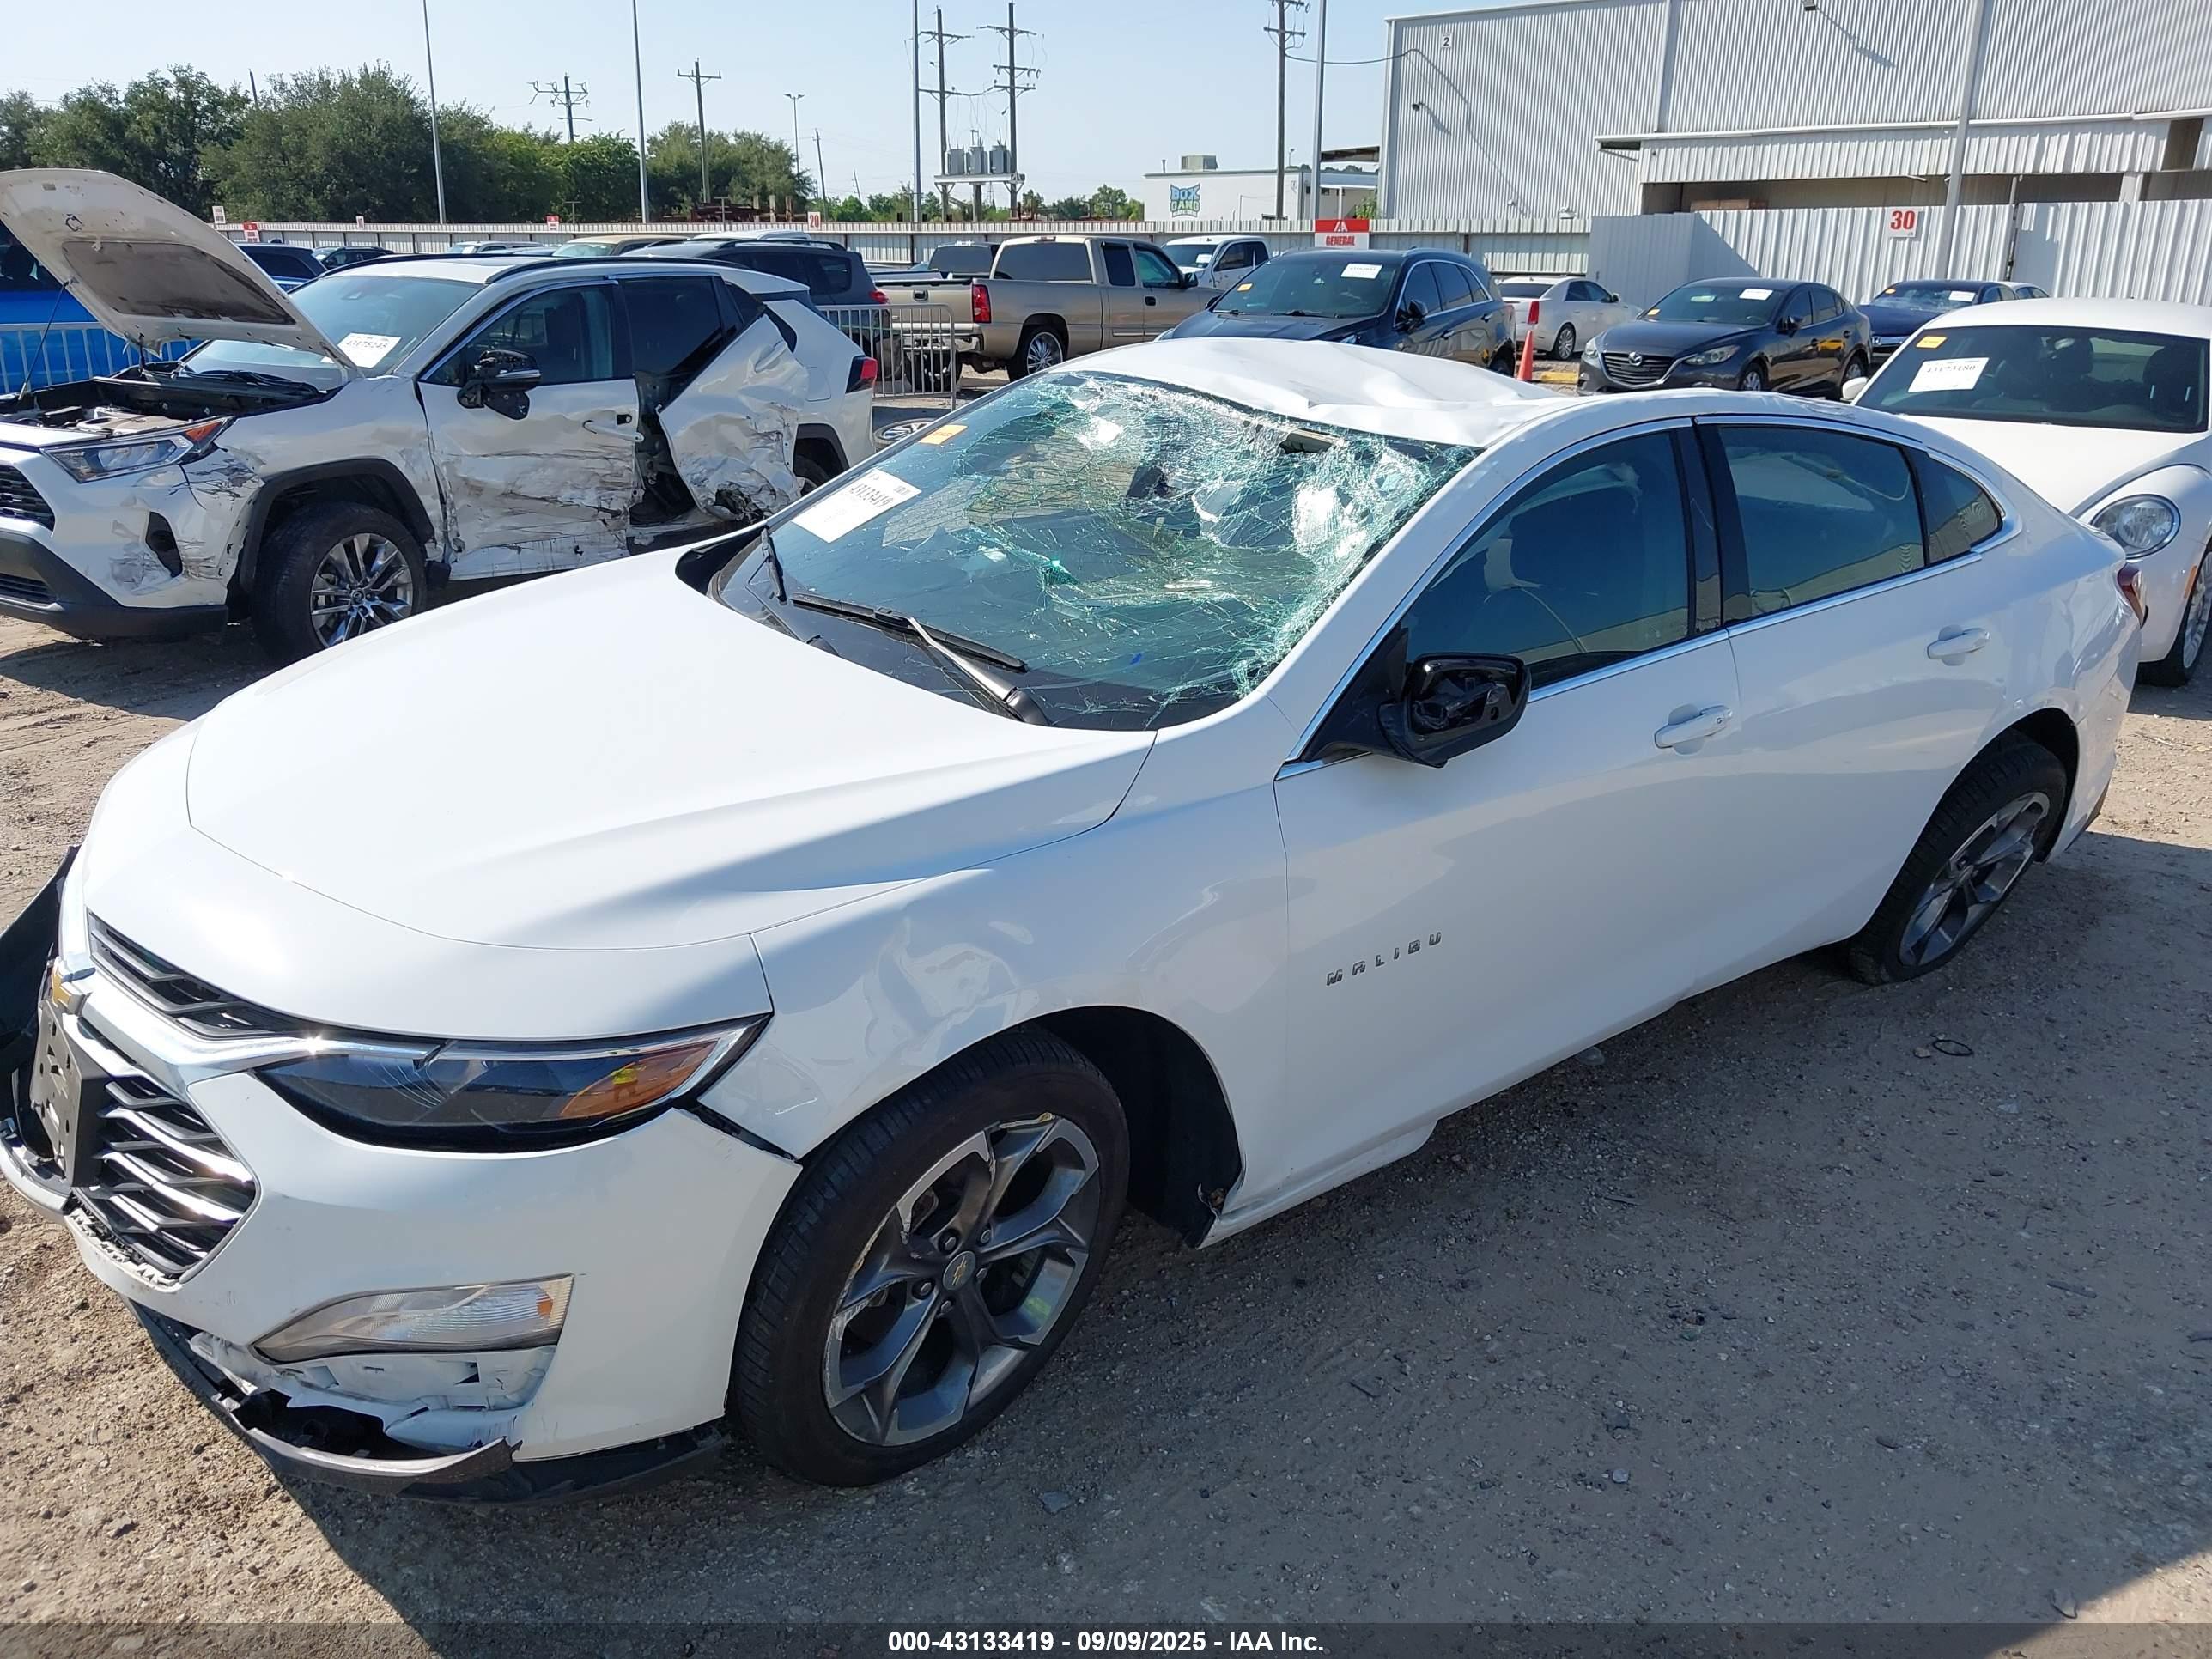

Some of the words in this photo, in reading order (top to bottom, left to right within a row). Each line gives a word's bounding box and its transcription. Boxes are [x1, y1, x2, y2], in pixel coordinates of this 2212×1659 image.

[1443, 36, 1450, 46] 2
[1170, 183, 1200, 200] BOX
[809, 214, 820, 228] 20
[1890, 210, 1916, 230] 30
[1325, 235, 1355, 246] GENERAL
[1326, 932, 1442, 987] MALIBU
